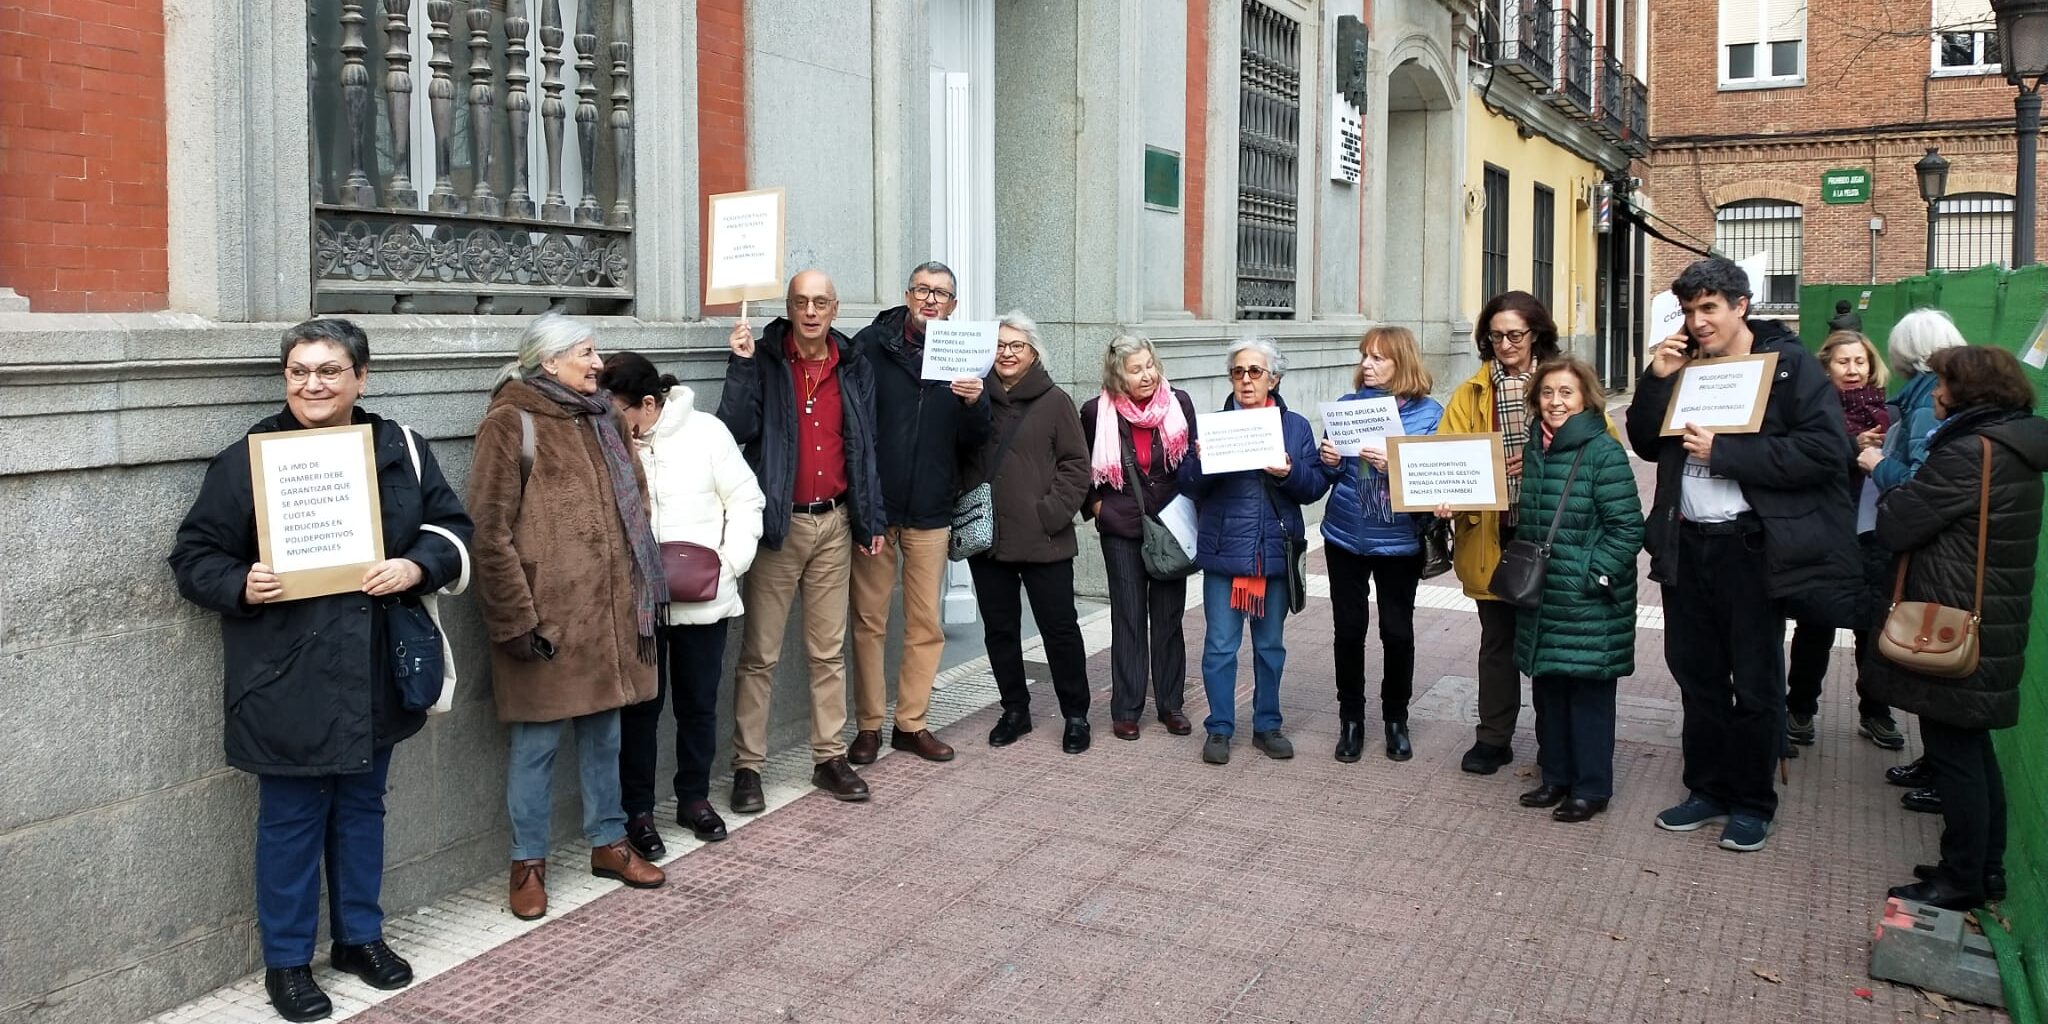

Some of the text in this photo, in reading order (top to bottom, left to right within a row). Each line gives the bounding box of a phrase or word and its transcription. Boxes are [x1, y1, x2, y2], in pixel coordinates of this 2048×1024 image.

[1352, 417, 1384, 426] REDUCIDAS
[1355, 426, 1384, 434] TENEMOS
[281, 485, 332, 496] GARANTIZAR
[294, 496, 333, 507] APLIQUEN
[283, 511, 316, 520] CUOTAS
[284, 521, 330, 532] REDUCIDAS
[286, 530, 354, 544] POLIDEPORTIVOS
[287, 544, 341, 556] MUNICIPALES
